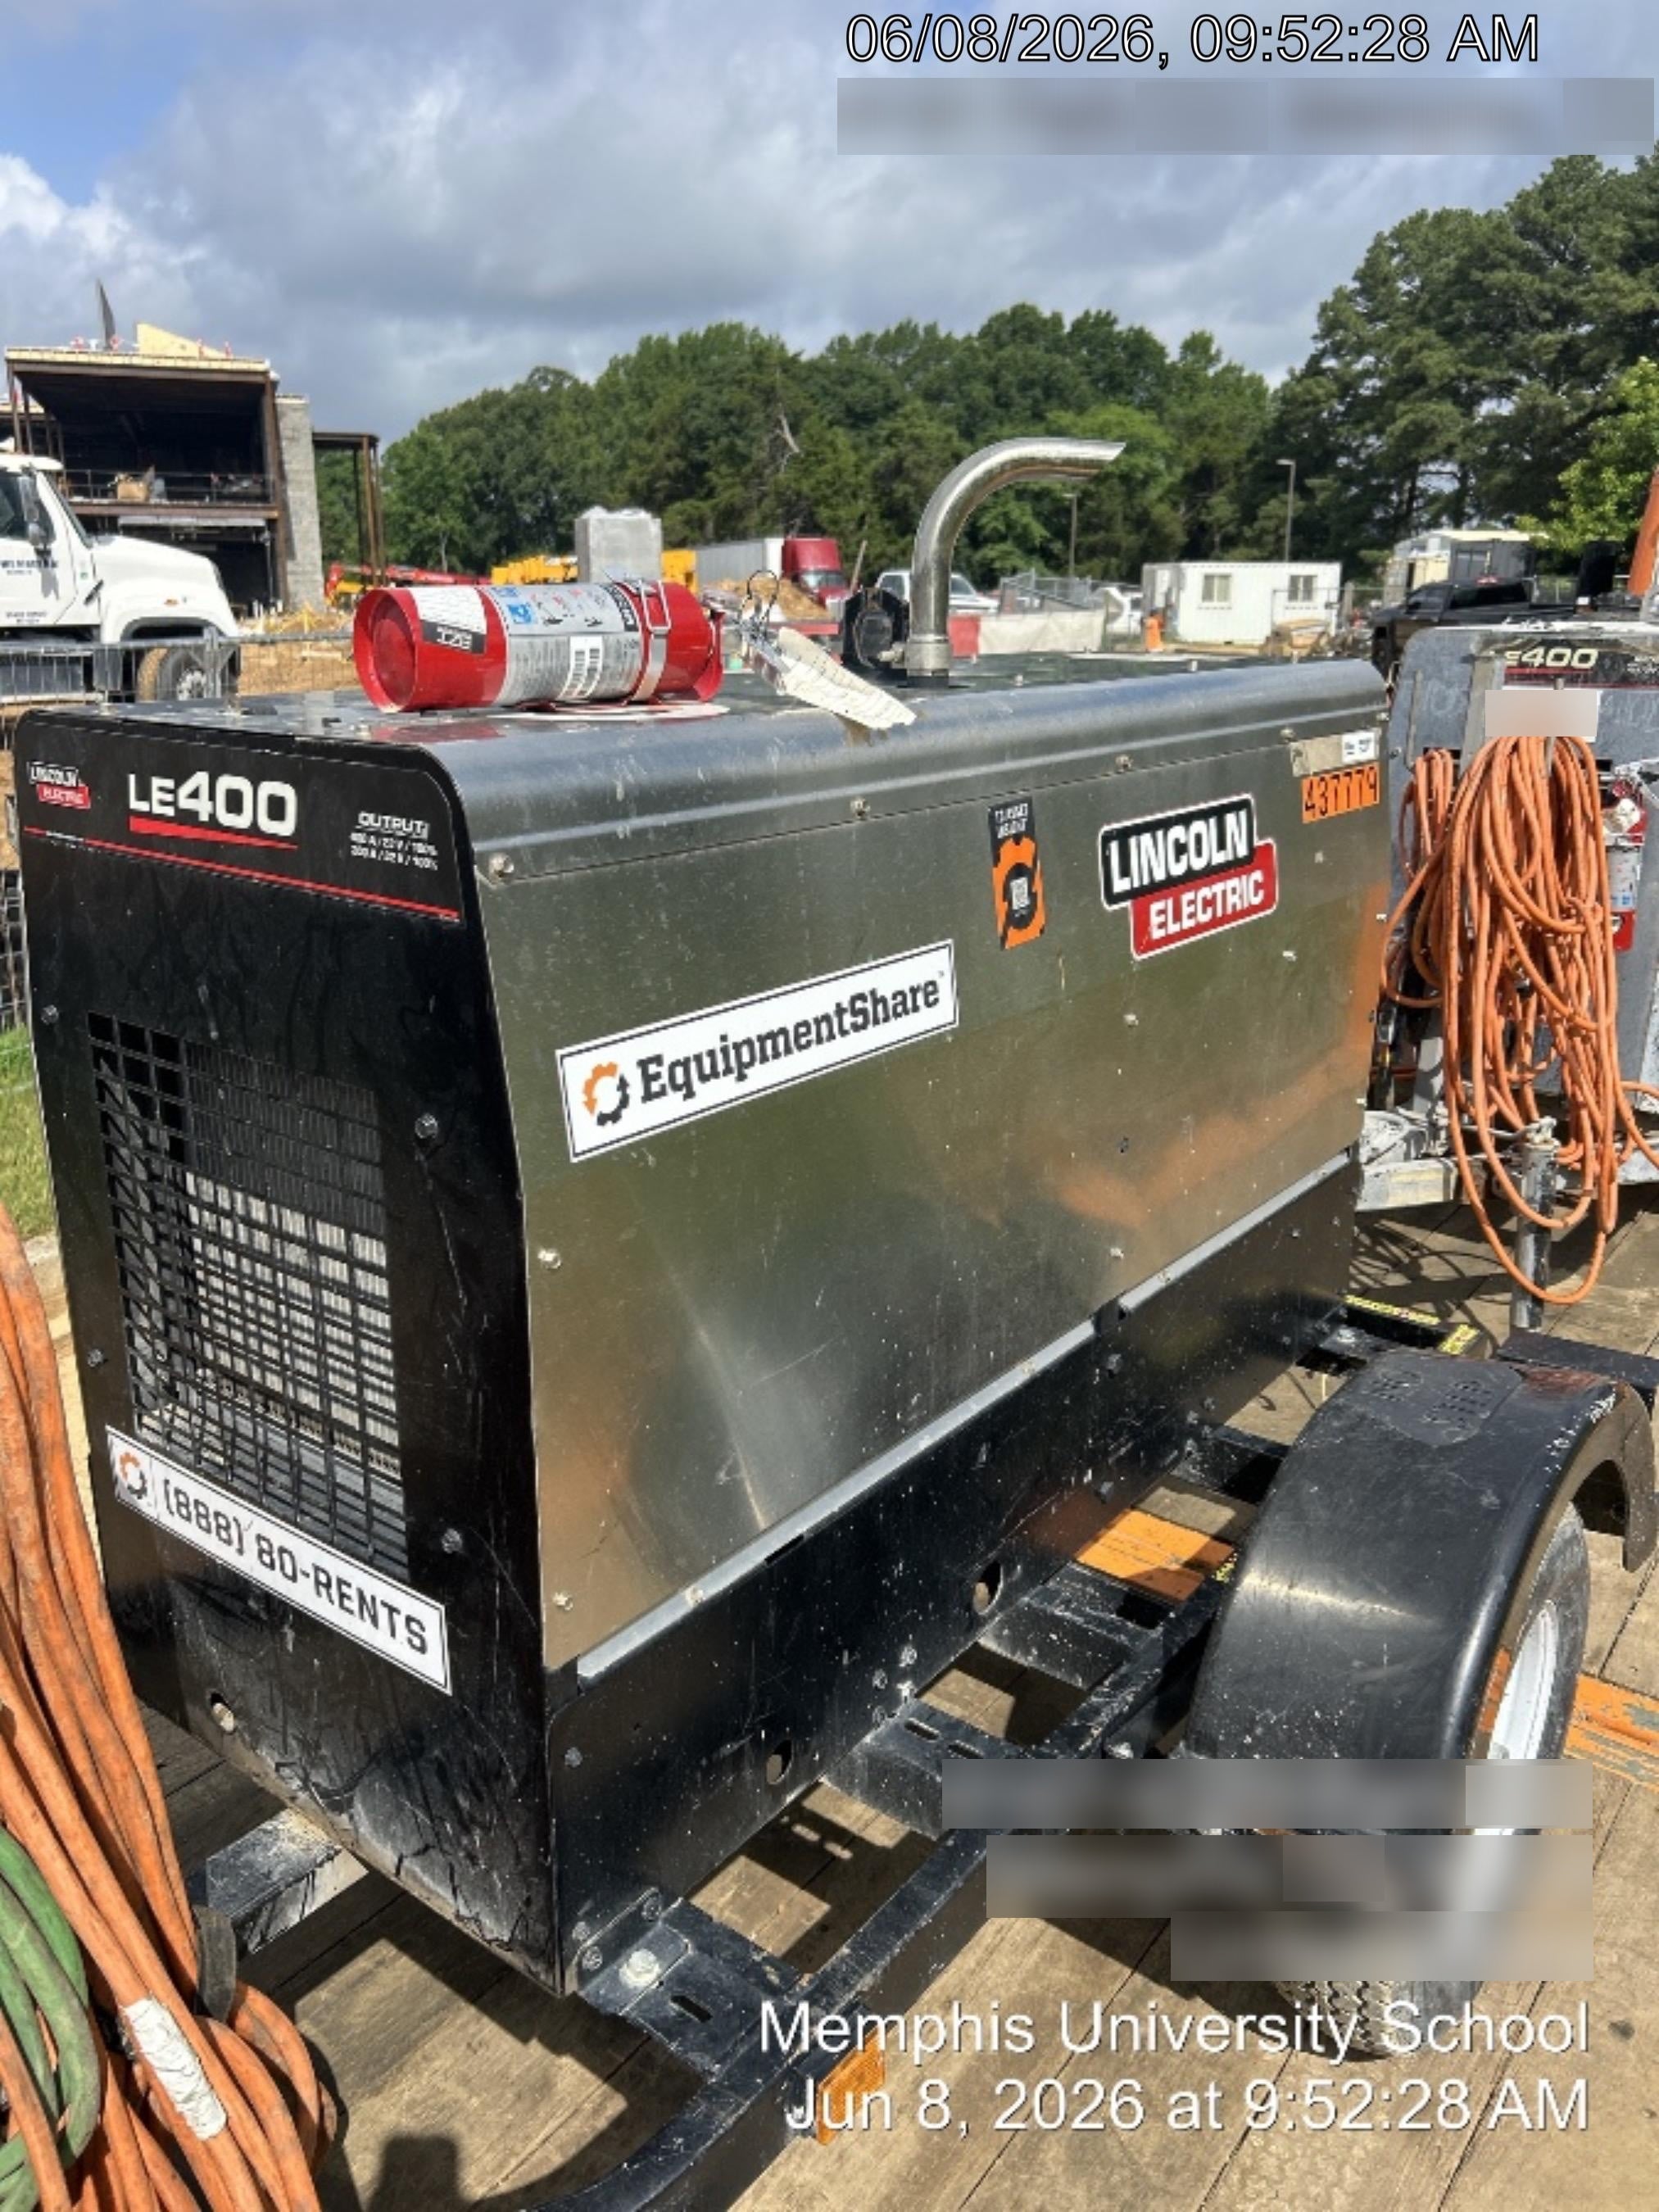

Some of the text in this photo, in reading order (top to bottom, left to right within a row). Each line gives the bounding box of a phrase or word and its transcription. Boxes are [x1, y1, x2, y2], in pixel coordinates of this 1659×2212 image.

[129, 771, 297, 836] LE400
[358, 811, 426, 836] OUTPUT
[1109, 809, 1249, 894] LINCOLN
[1149, 869, 1264, 941] ELECTRIC
[636, 978, 941, 1104] EquipmentShare
[164, 1479, 428, 1657] (888) 80-RENTS
